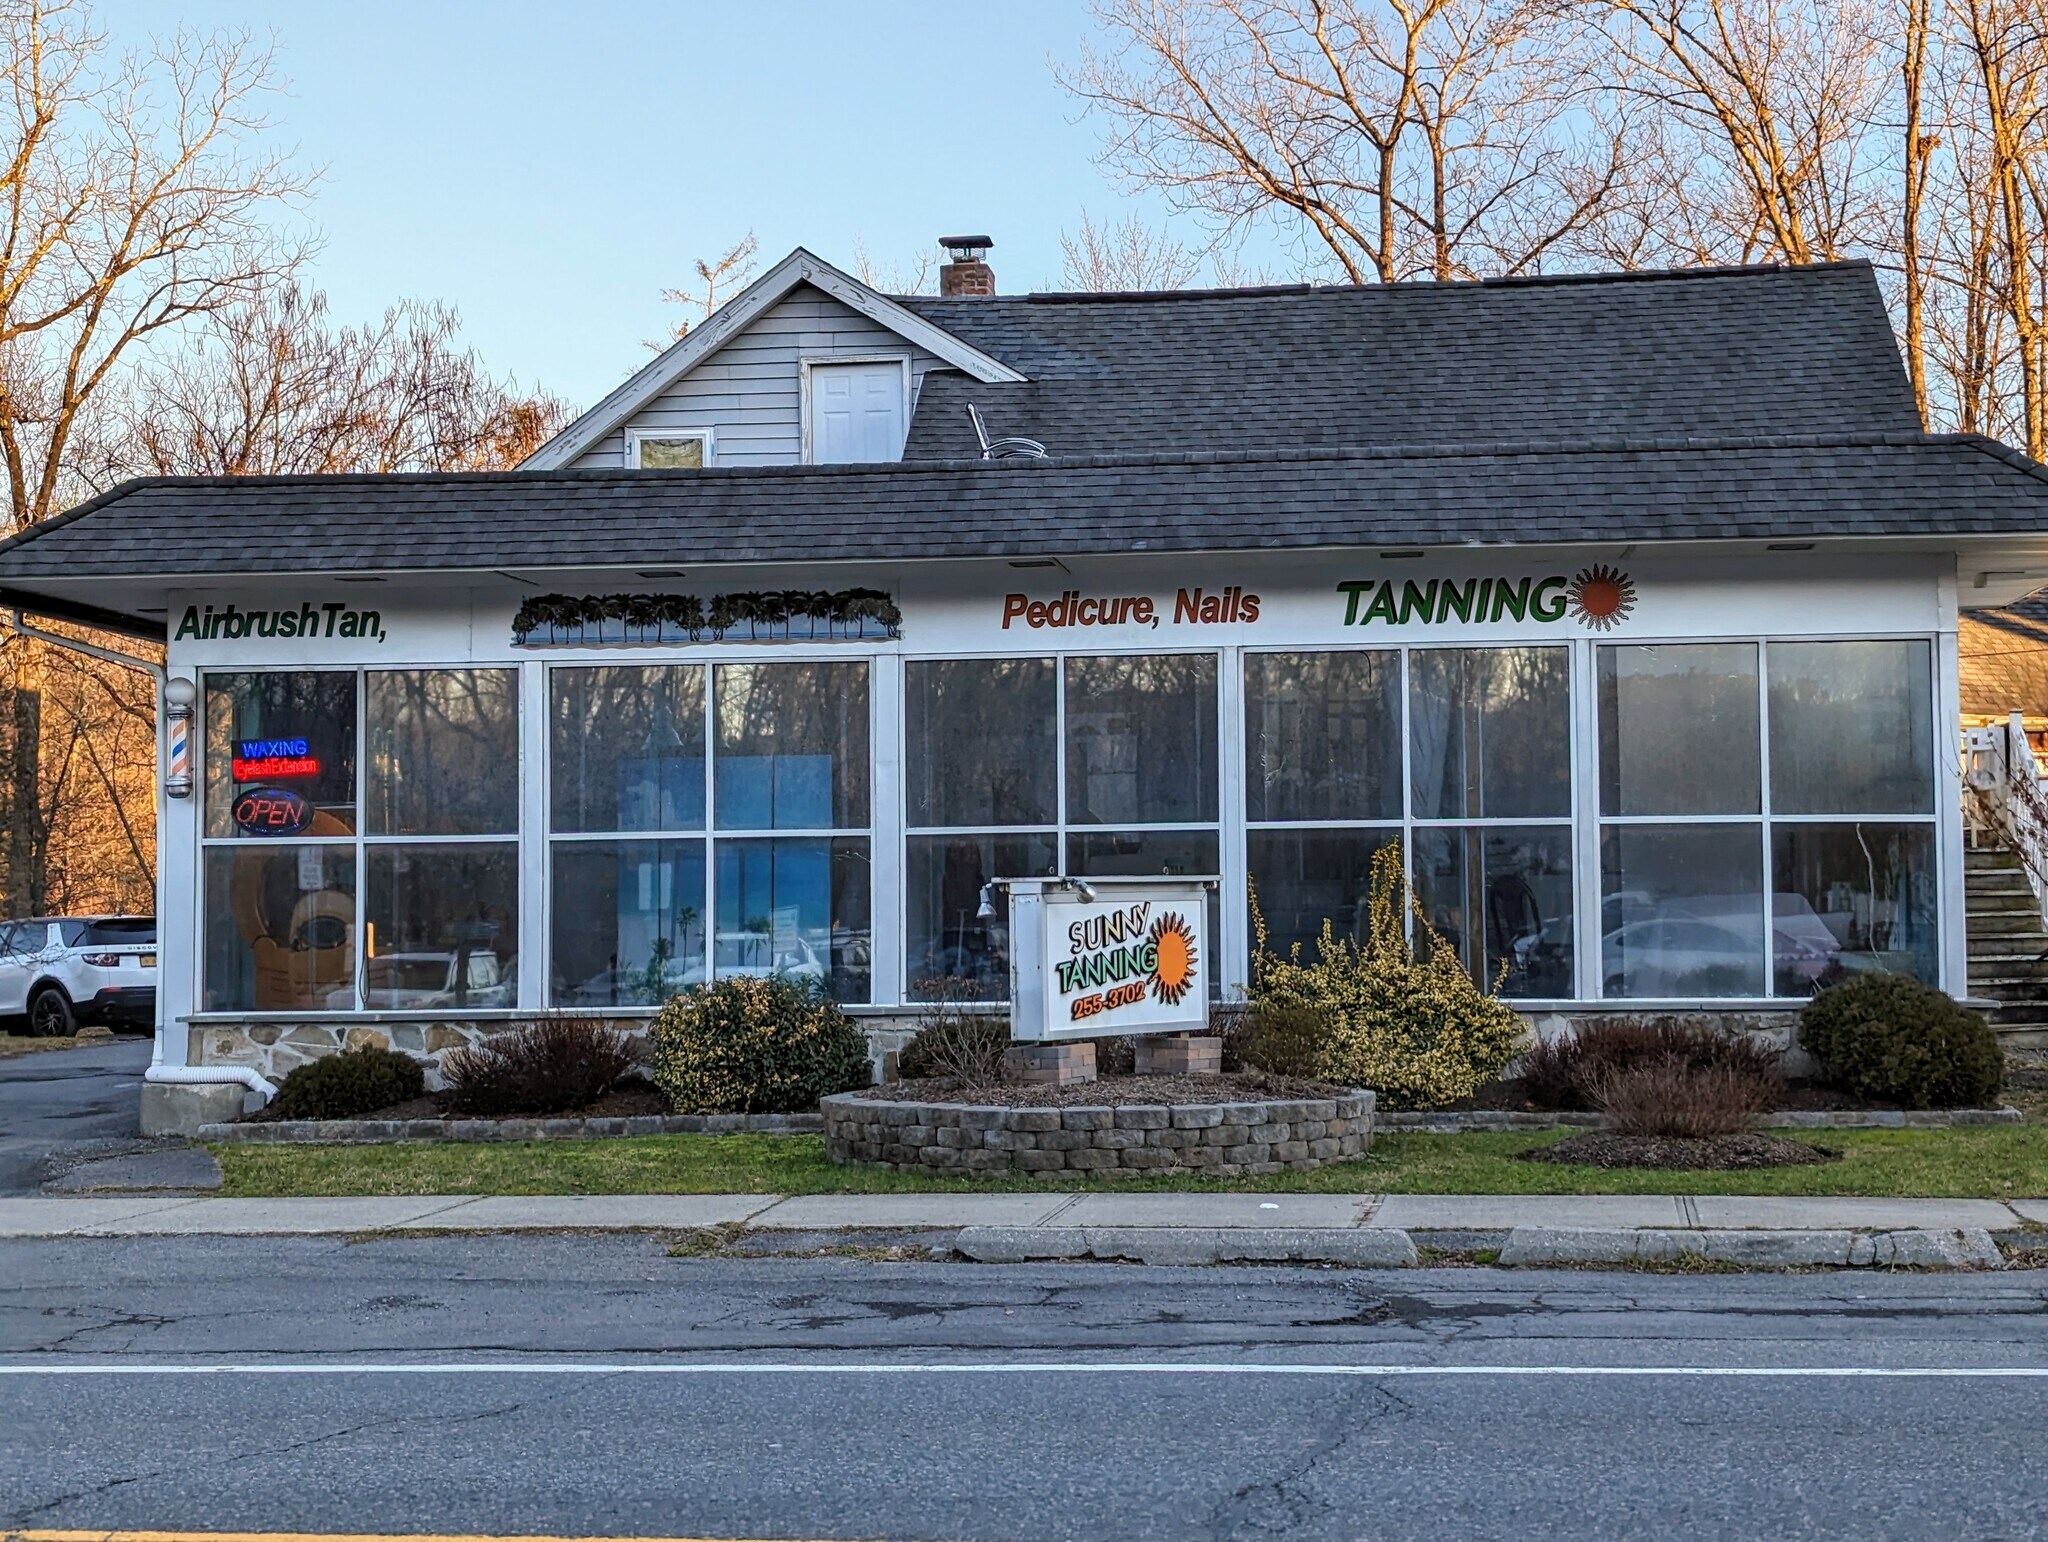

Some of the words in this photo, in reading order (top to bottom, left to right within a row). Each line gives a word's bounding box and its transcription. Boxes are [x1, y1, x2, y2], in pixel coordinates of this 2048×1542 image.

[1001, 589, 1160, 630] Pedicure,
[1173, 586, 1261, 625] Nails
[1336, 576, 1568, 626] TANNING
[242, 740, 308, 758] WAXING
[236, 799, 304, 825] OPEN
[1069, 901, 1150, 954] SUNNY
[1055, 941, 1159, 994] TANNING
[1071, 981, 1146, 1020] 255-3702
